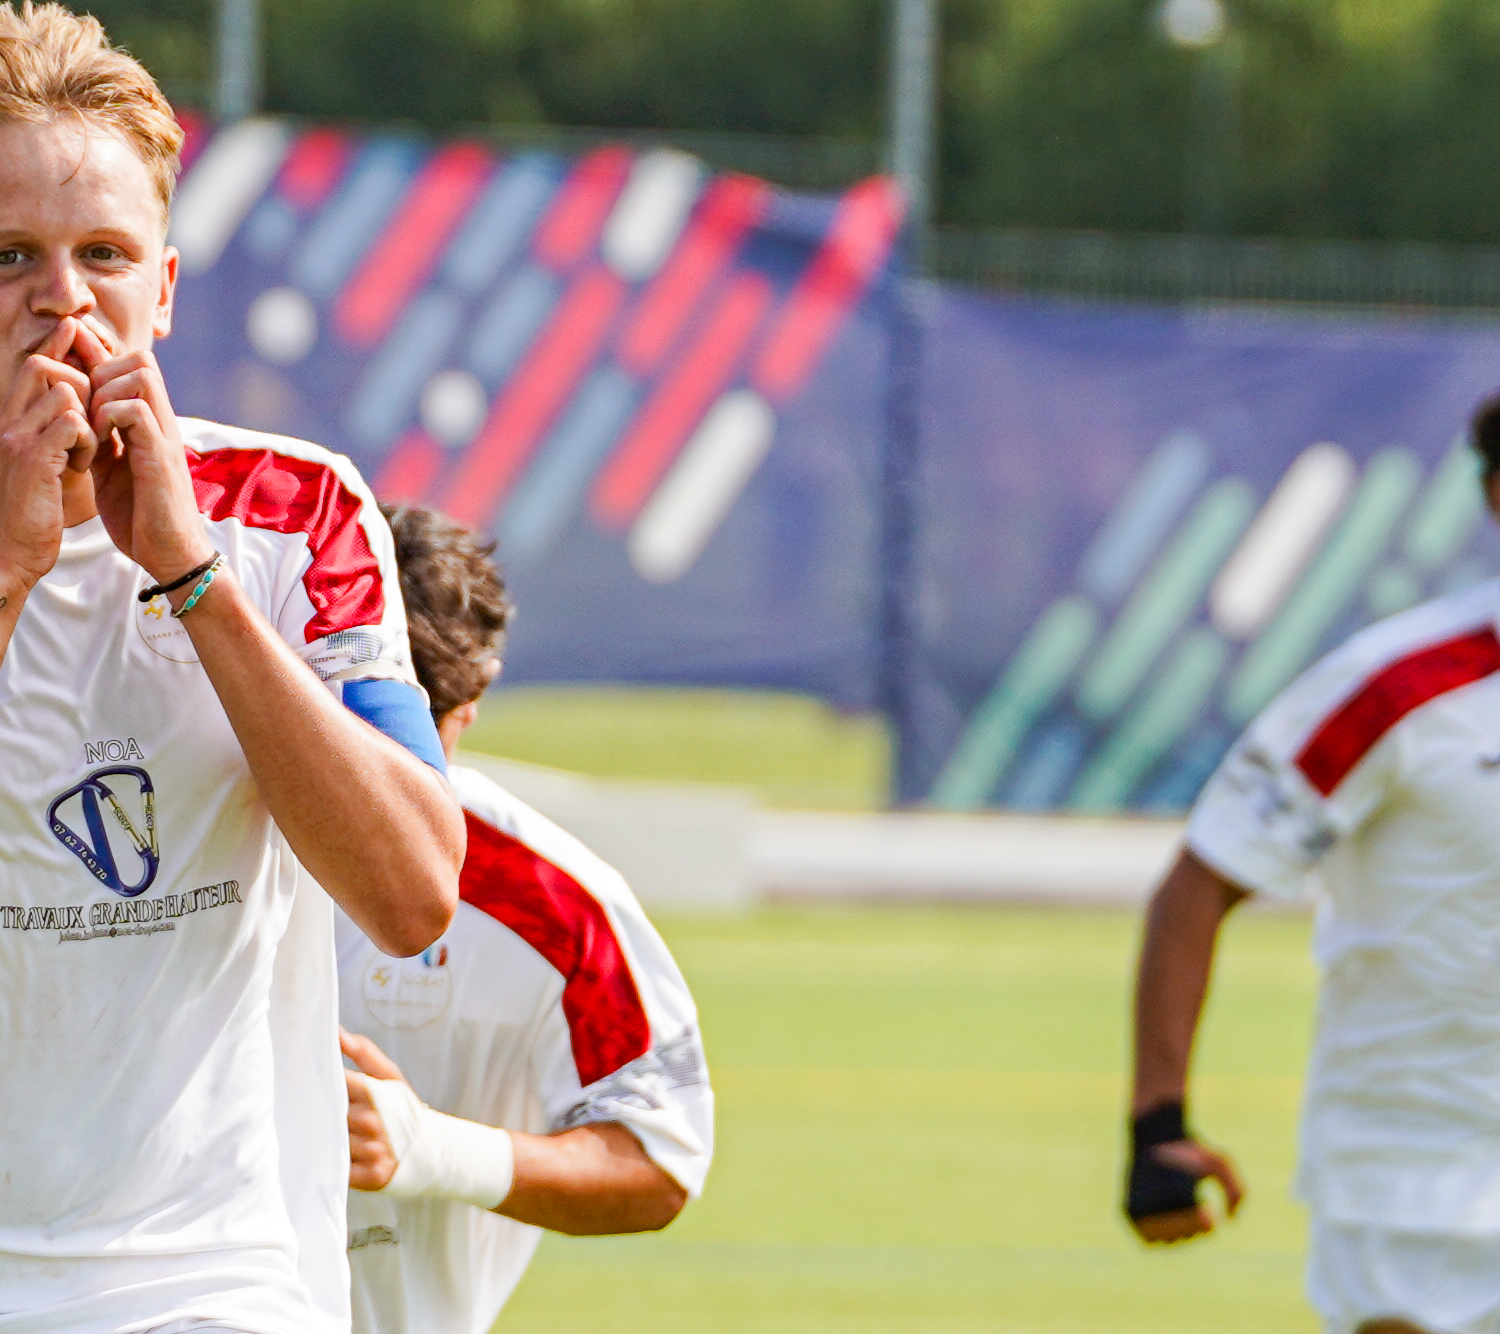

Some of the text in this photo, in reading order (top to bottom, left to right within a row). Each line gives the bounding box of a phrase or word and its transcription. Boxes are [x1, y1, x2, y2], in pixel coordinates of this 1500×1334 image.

[84, 738, 144, 764] NOA
[0, 879, 243, 930] TRAVAUX GRANDE HAUTEUR
